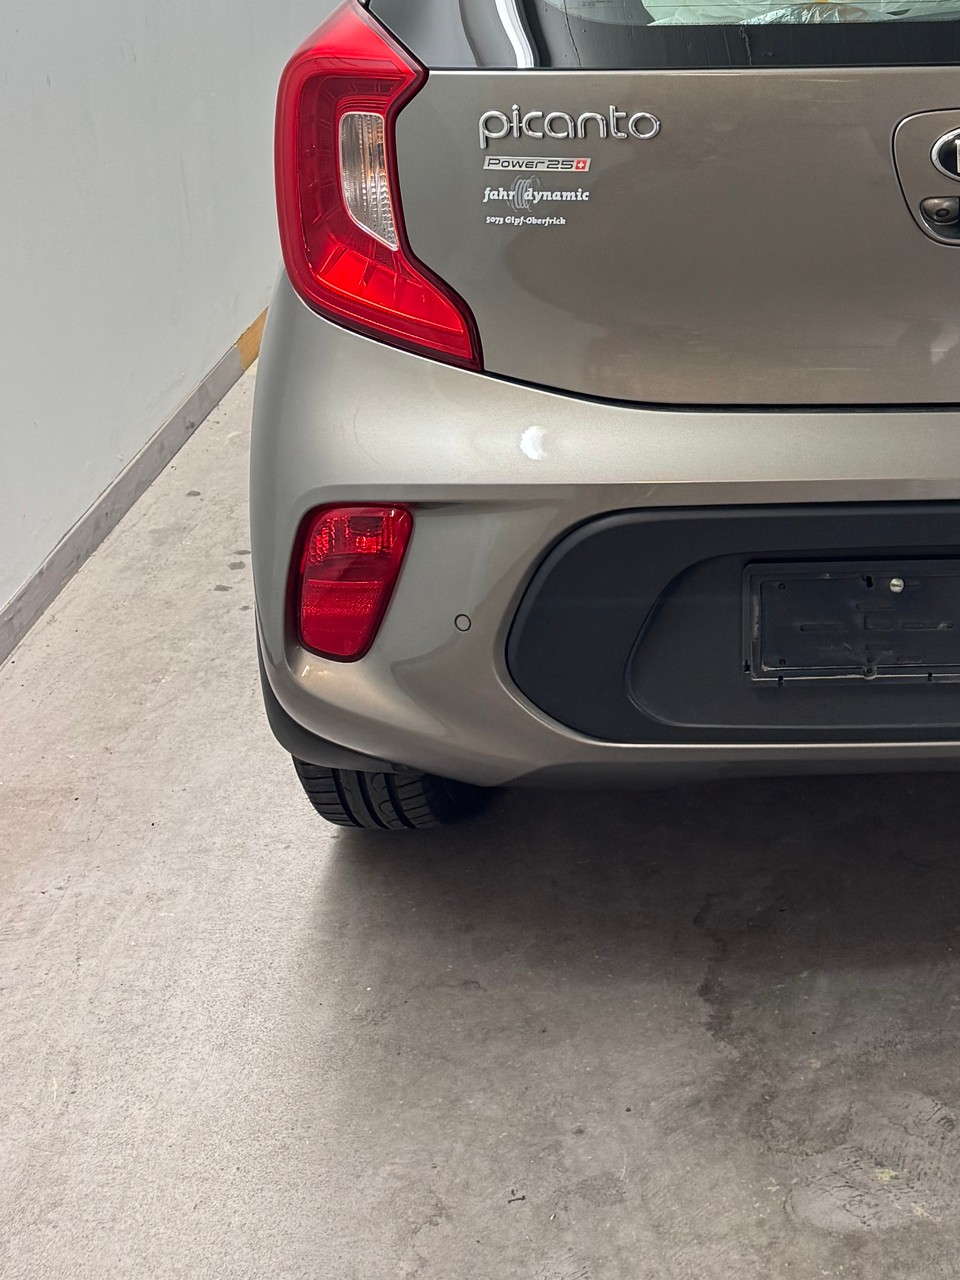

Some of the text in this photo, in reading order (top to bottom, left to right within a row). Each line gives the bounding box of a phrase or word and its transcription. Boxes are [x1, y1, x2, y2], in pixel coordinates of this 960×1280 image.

[478, 104, 661, 150] picanto
[483, 187, 589, 204] fahr dynamic
[486, 216, 566, 226] 5073 Gipf-Oberfrick
